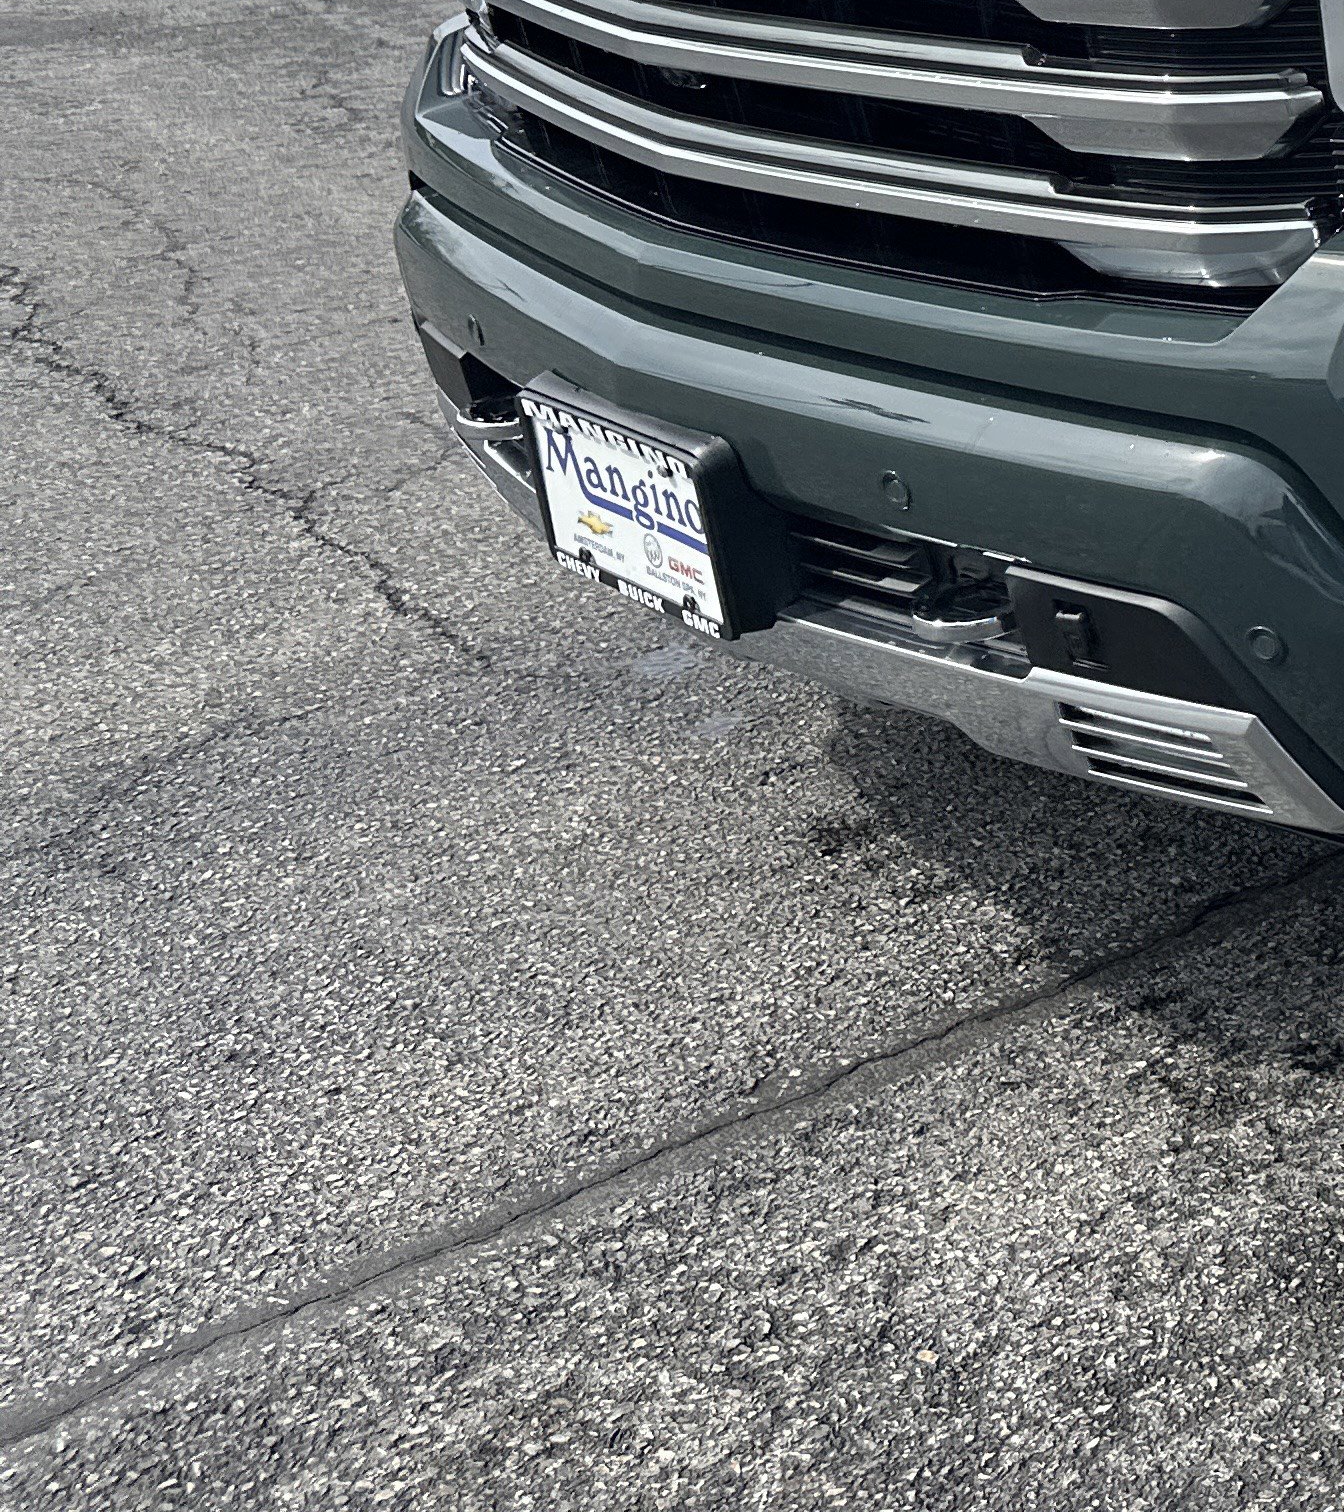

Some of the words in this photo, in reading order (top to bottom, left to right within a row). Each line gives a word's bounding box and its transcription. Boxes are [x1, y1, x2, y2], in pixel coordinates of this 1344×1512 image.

[520, 398, 689, 480] MANGINO
[545, 427, 708, 550] Mangino
[556, 551, 601, 583] CHEVY
[617, 579, 665, 614] BUICK
[681, 609, 721, 639] GMC
[646, 565, 682, 589] BALLSTON
[668, 555, 705, 586] GMC
